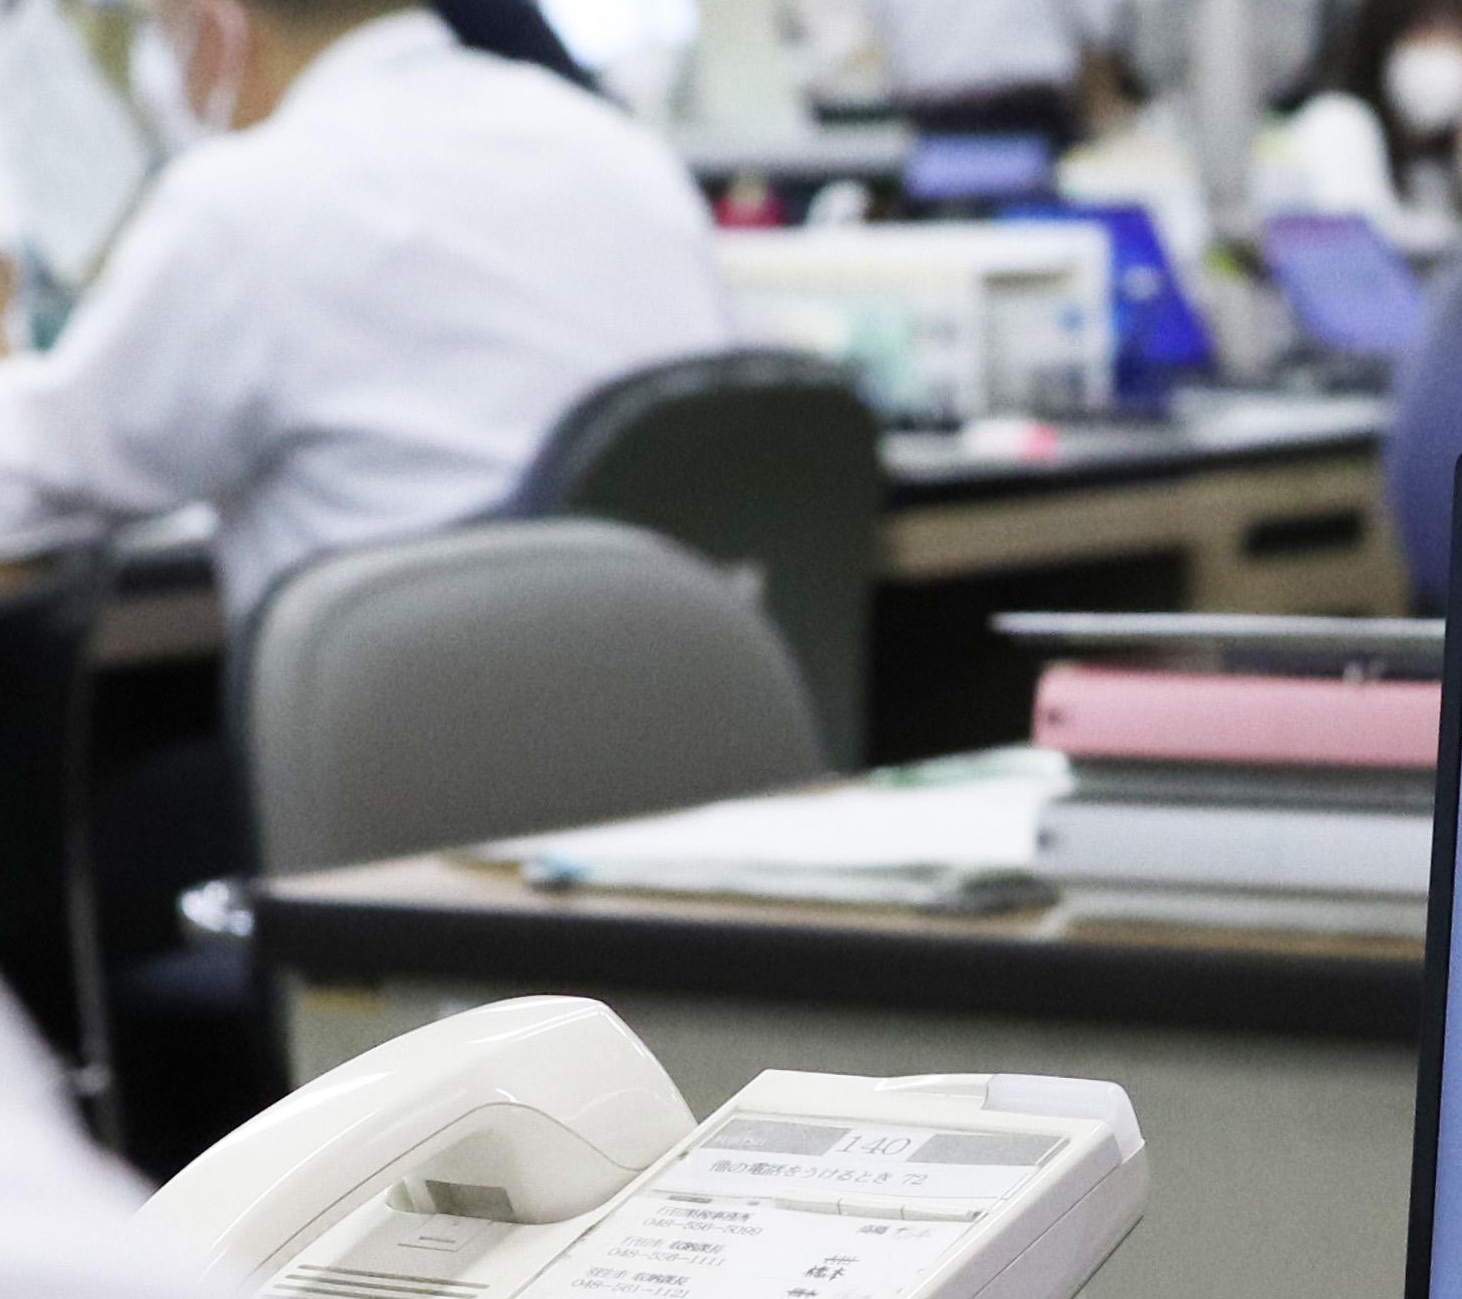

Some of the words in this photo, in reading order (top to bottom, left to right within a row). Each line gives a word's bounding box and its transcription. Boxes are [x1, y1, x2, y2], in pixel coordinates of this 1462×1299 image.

[837, 1134, 914, 1157] 140
[708, 1158, 894, 1185] 他の電話をうけるとき
[902, 1172, 929, 1186] 72
